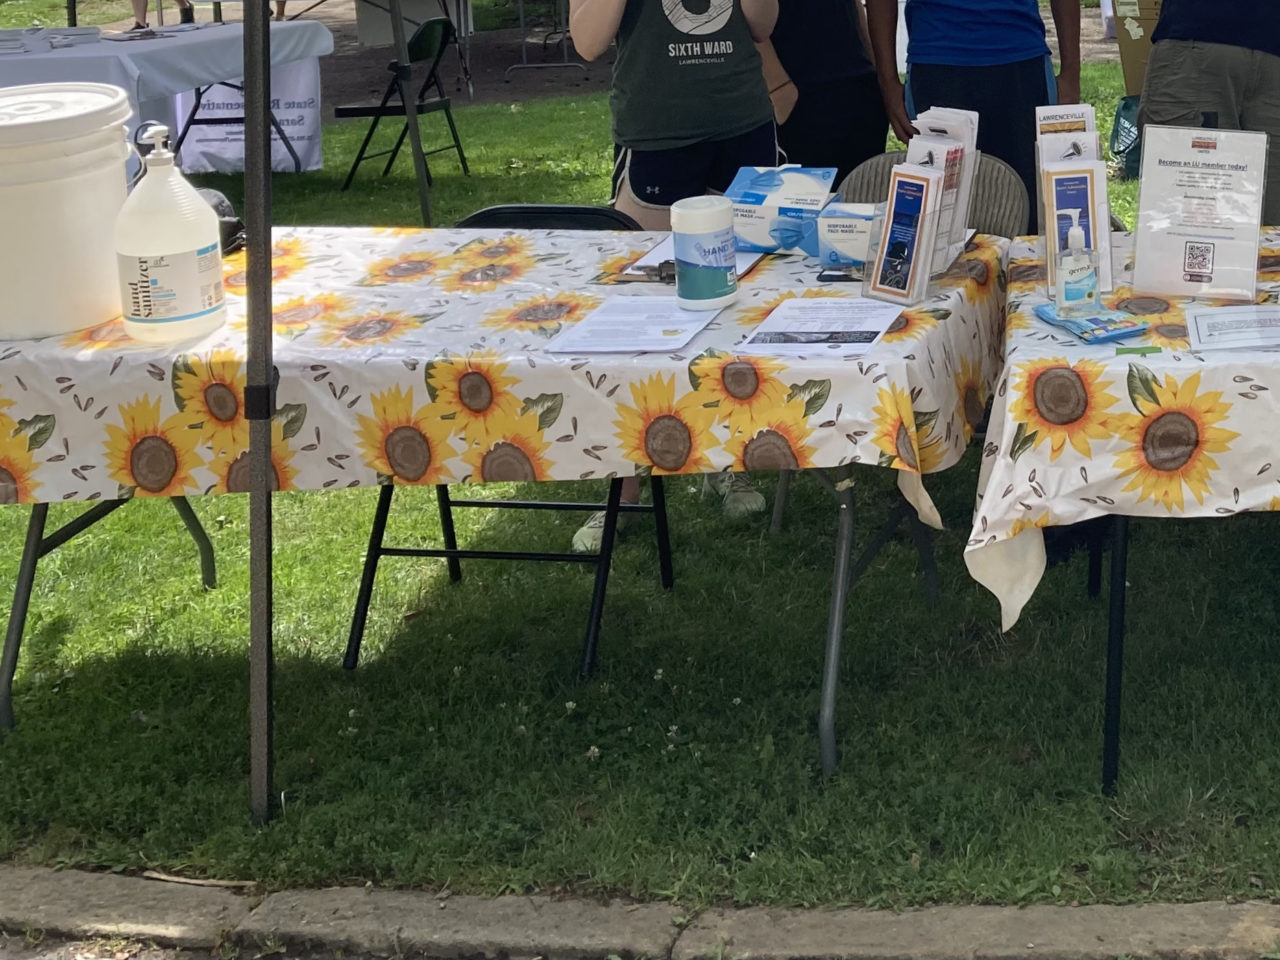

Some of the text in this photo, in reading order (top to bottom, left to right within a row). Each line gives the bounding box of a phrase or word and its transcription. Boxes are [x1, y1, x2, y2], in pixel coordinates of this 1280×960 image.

[668, 41, 733, 57] SIXTH WARD
[1158, 159, 1181, 168] Become
[1202, 162, 1227, 171] member
[703, 245, 728, 257] HAND
[138, 257, 152, 318] sanitizer
[128, 282, 141, 317] hand
